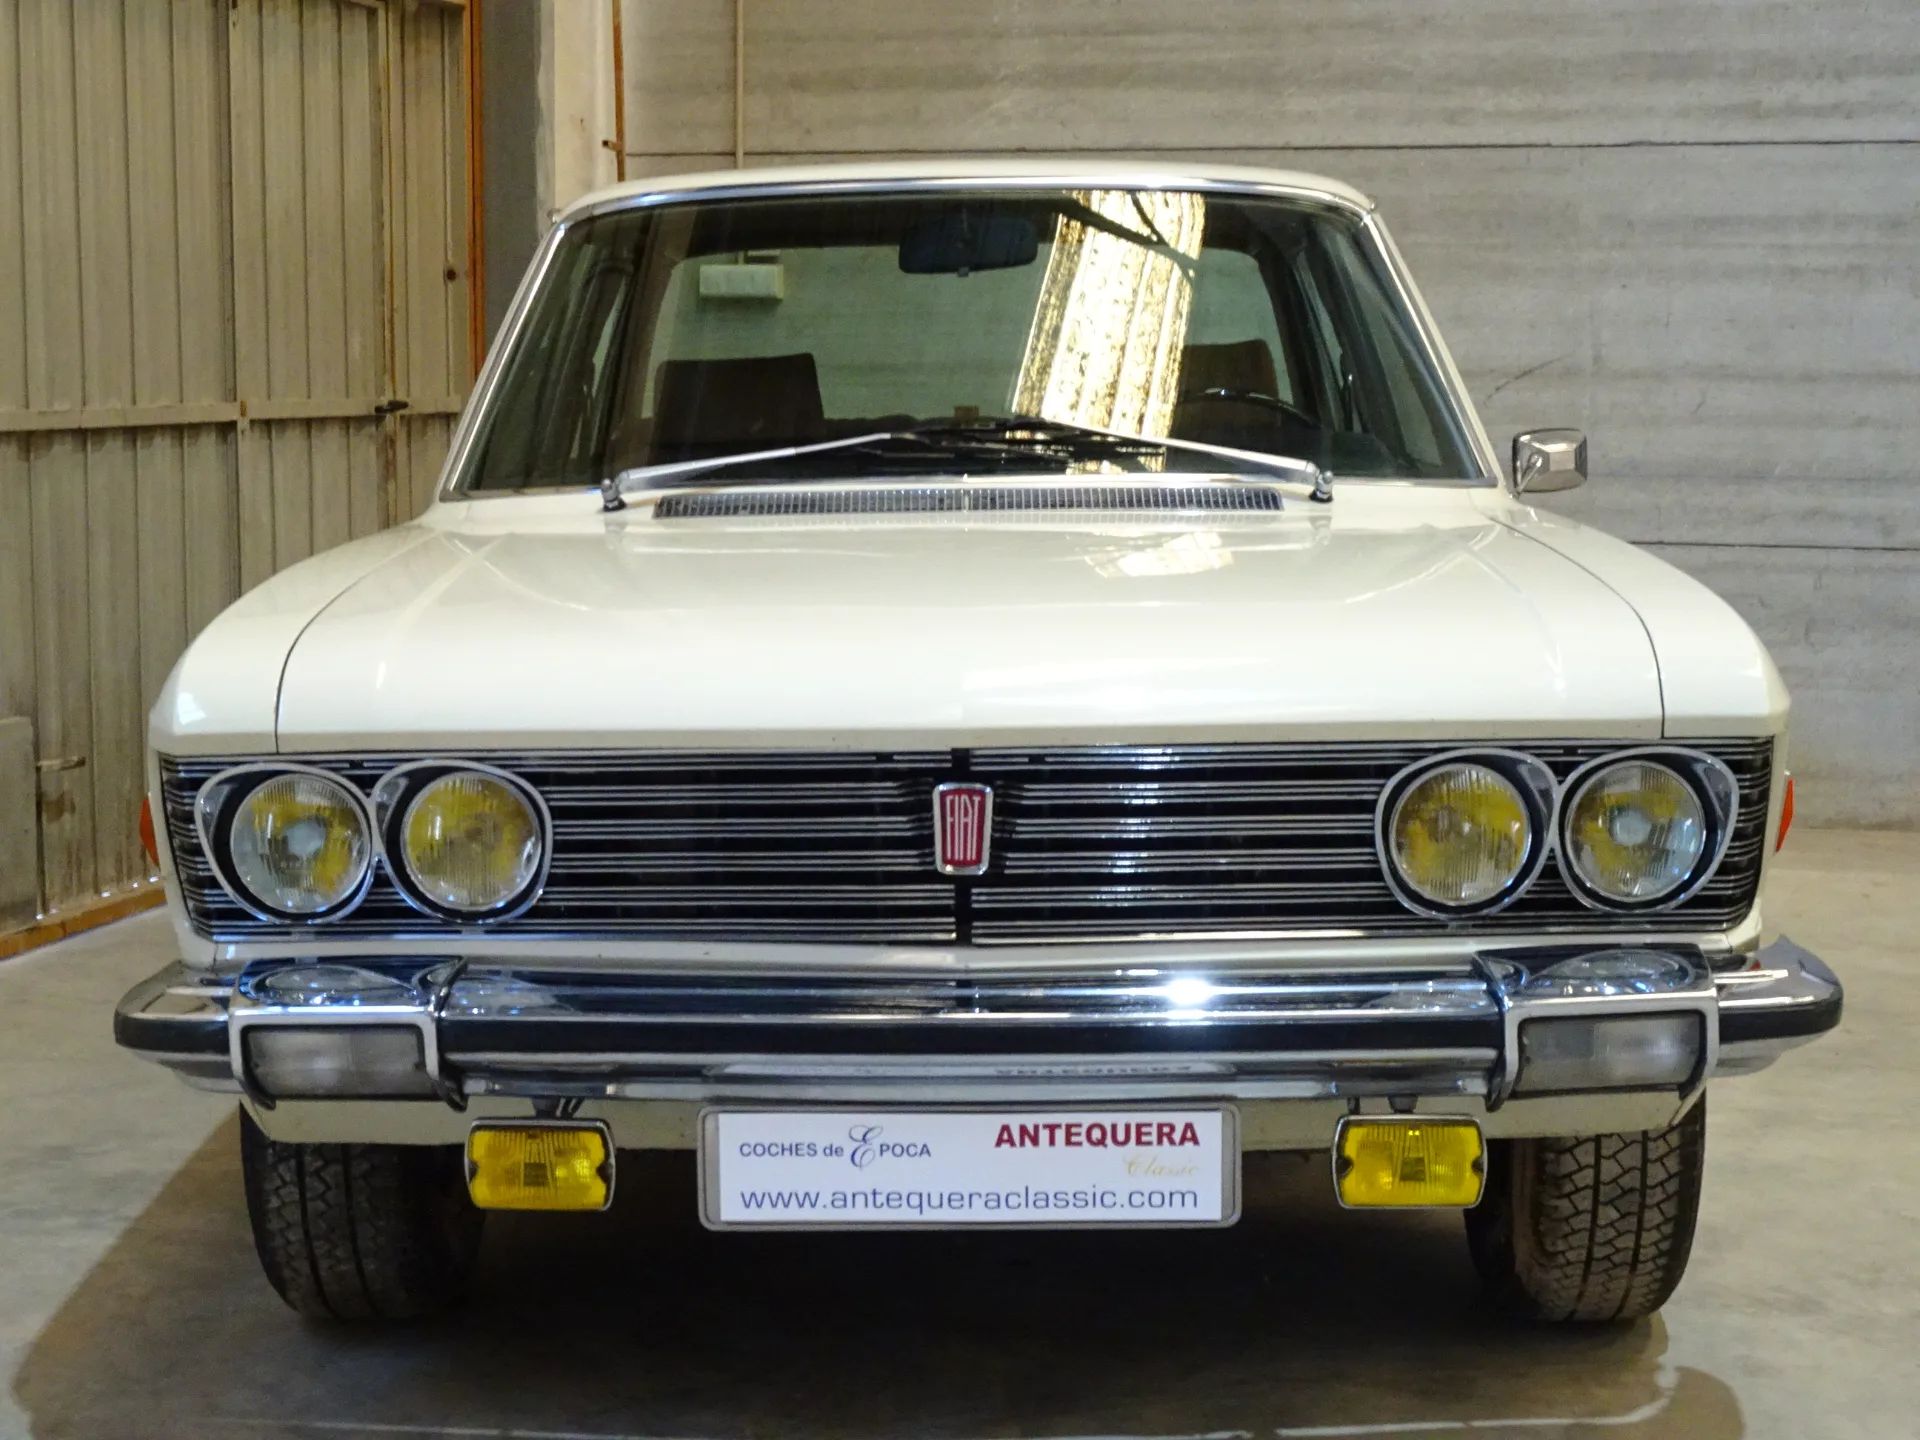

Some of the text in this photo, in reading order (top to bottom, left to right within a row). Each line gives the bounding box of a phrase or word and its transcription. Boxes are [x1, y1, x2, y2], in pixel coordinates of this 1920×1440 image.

[946, 794, 981, 861] FIAT
[994, 1122, 1200, 1148] ANTEQUERA
[739, 1142, 818, 1157] COCHES
[823, 1143, 844, 1157] de
[740, 1185, 1199, 1215] www.antequeraclassic.com
